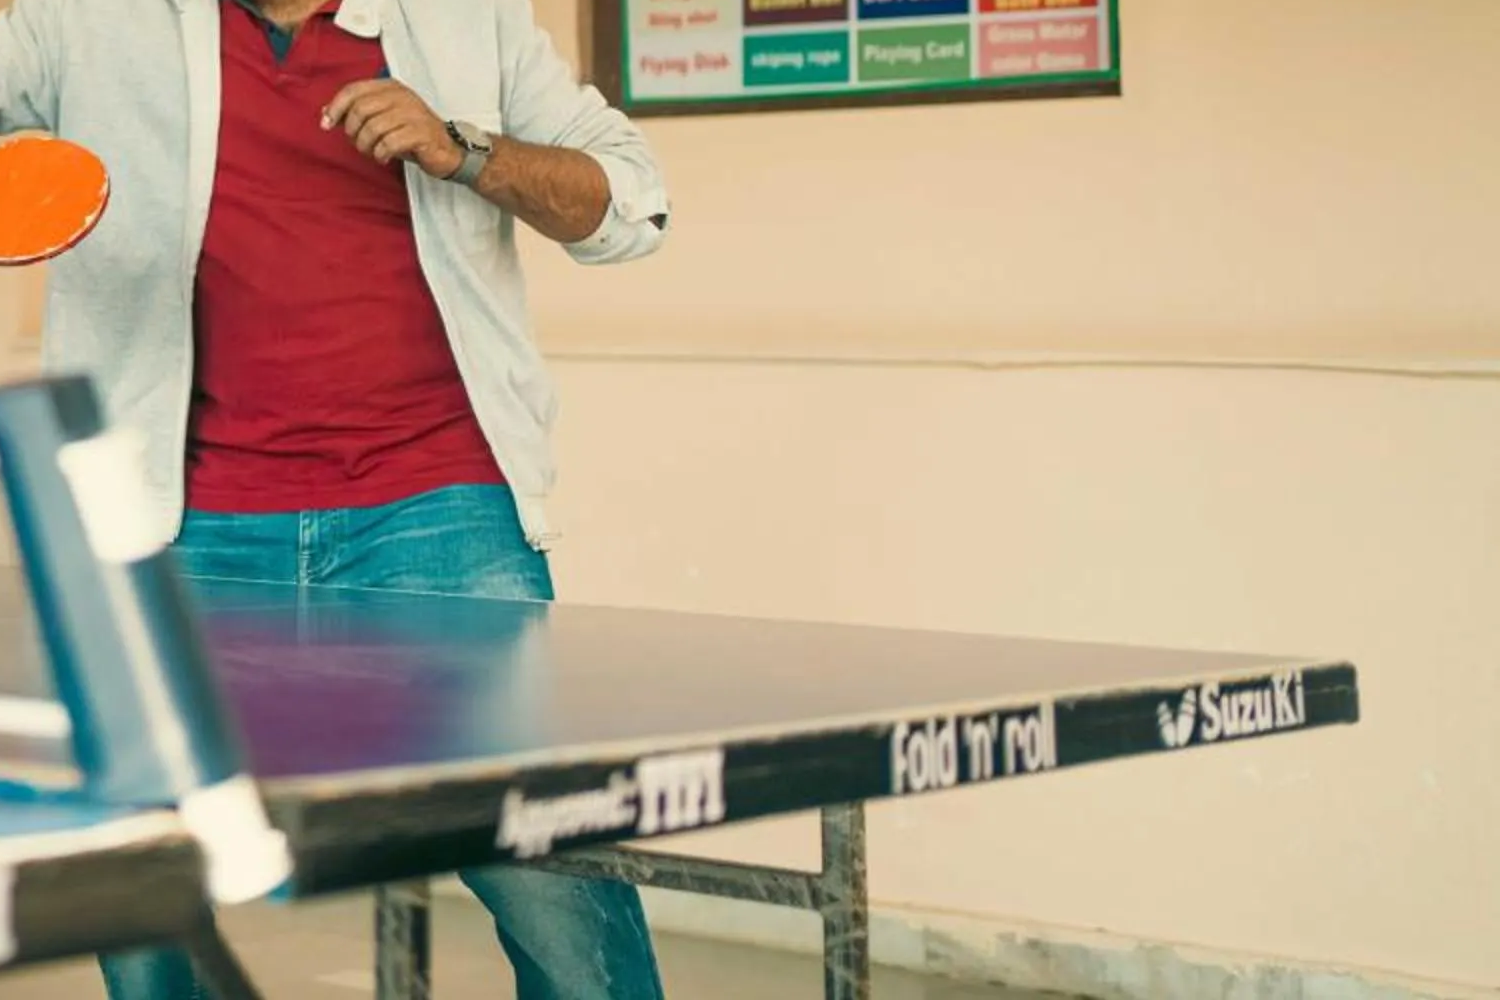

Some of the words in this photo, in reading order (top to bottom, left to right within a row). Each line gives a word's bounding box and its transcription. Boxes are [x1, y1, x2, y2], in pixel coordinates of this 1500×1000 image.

[864, 44, 922, 65] Playing
[926, 41, 965, 59] Card
[891, 714, 958, 793] Fold
[1005, 700, 1057, 774] roll
